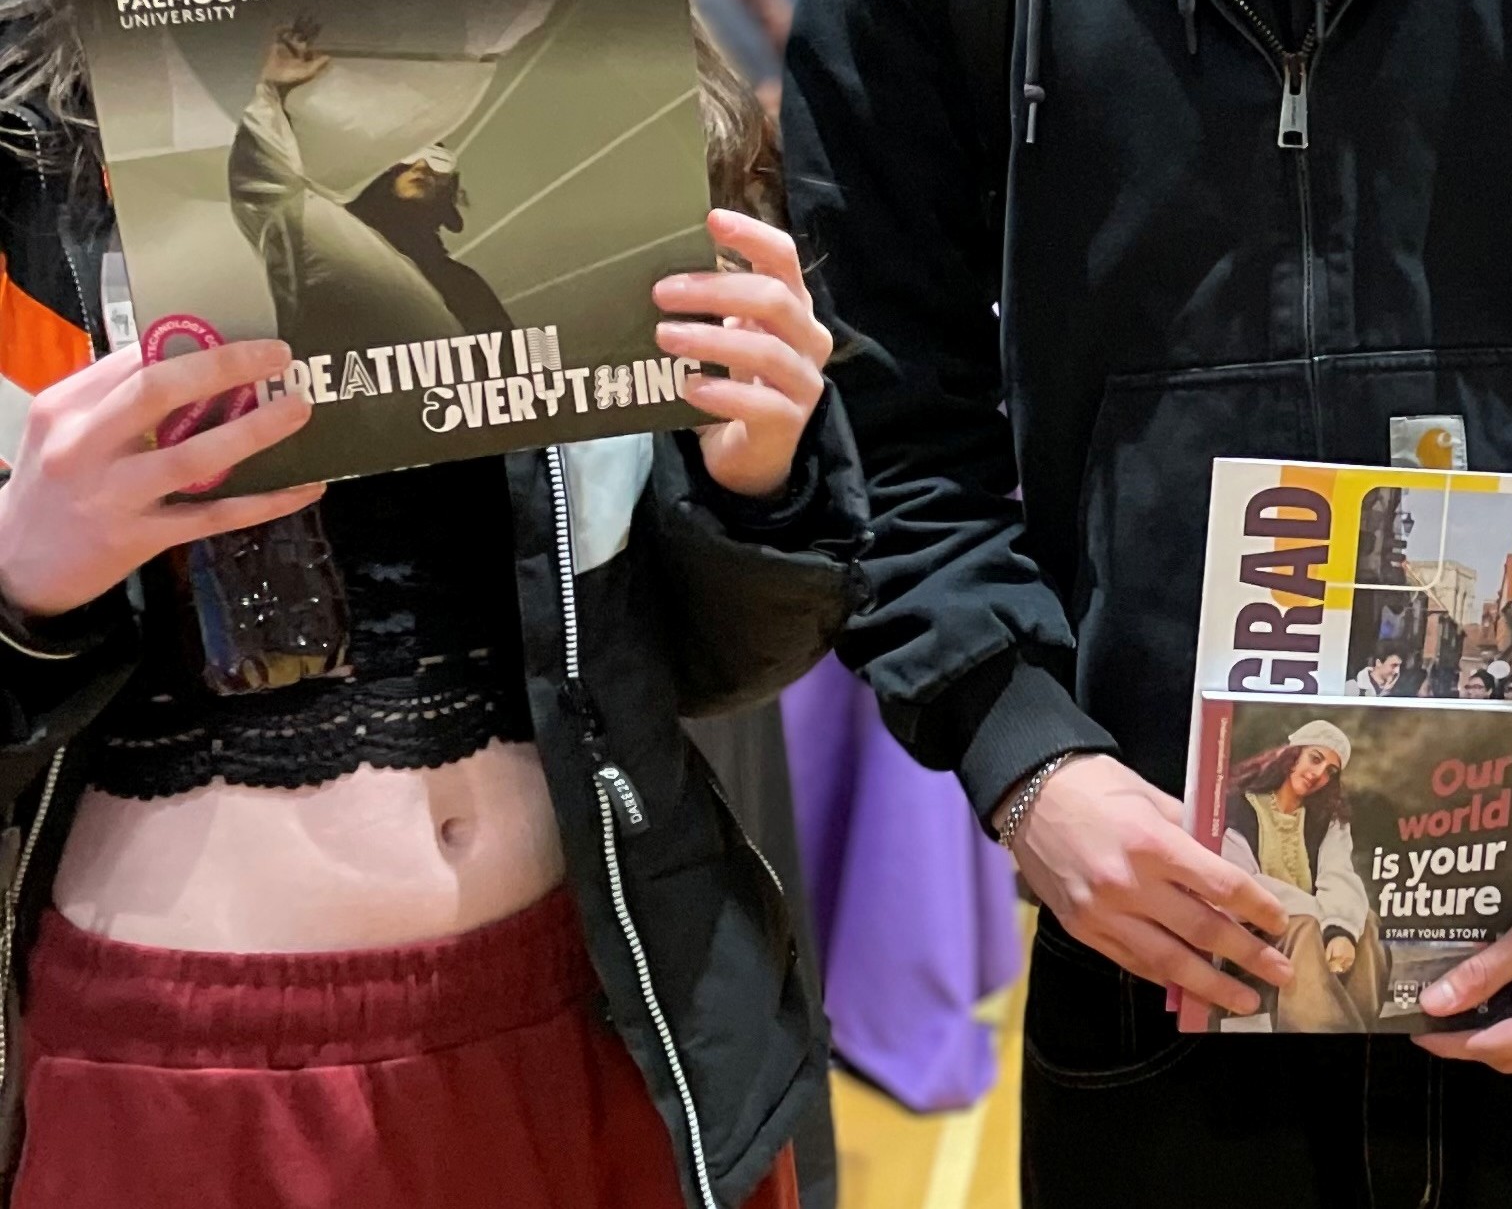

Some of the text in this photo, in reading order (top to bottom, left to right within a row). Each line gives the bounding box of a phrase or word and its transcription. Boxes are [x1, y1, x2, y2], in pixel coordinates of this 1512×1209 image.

[120, 6, 236, 30] UNIVERSITY
[512, 325, 563, 373] IN
[1228, 487, 1331, 695] GRAD
[1398, 788, 1512, 841] world
[1372, 841, 1507, 887] is your
[1378, 882, 1502, 917] future
[1385, 928, 1487, 939] START YOUR STORY
